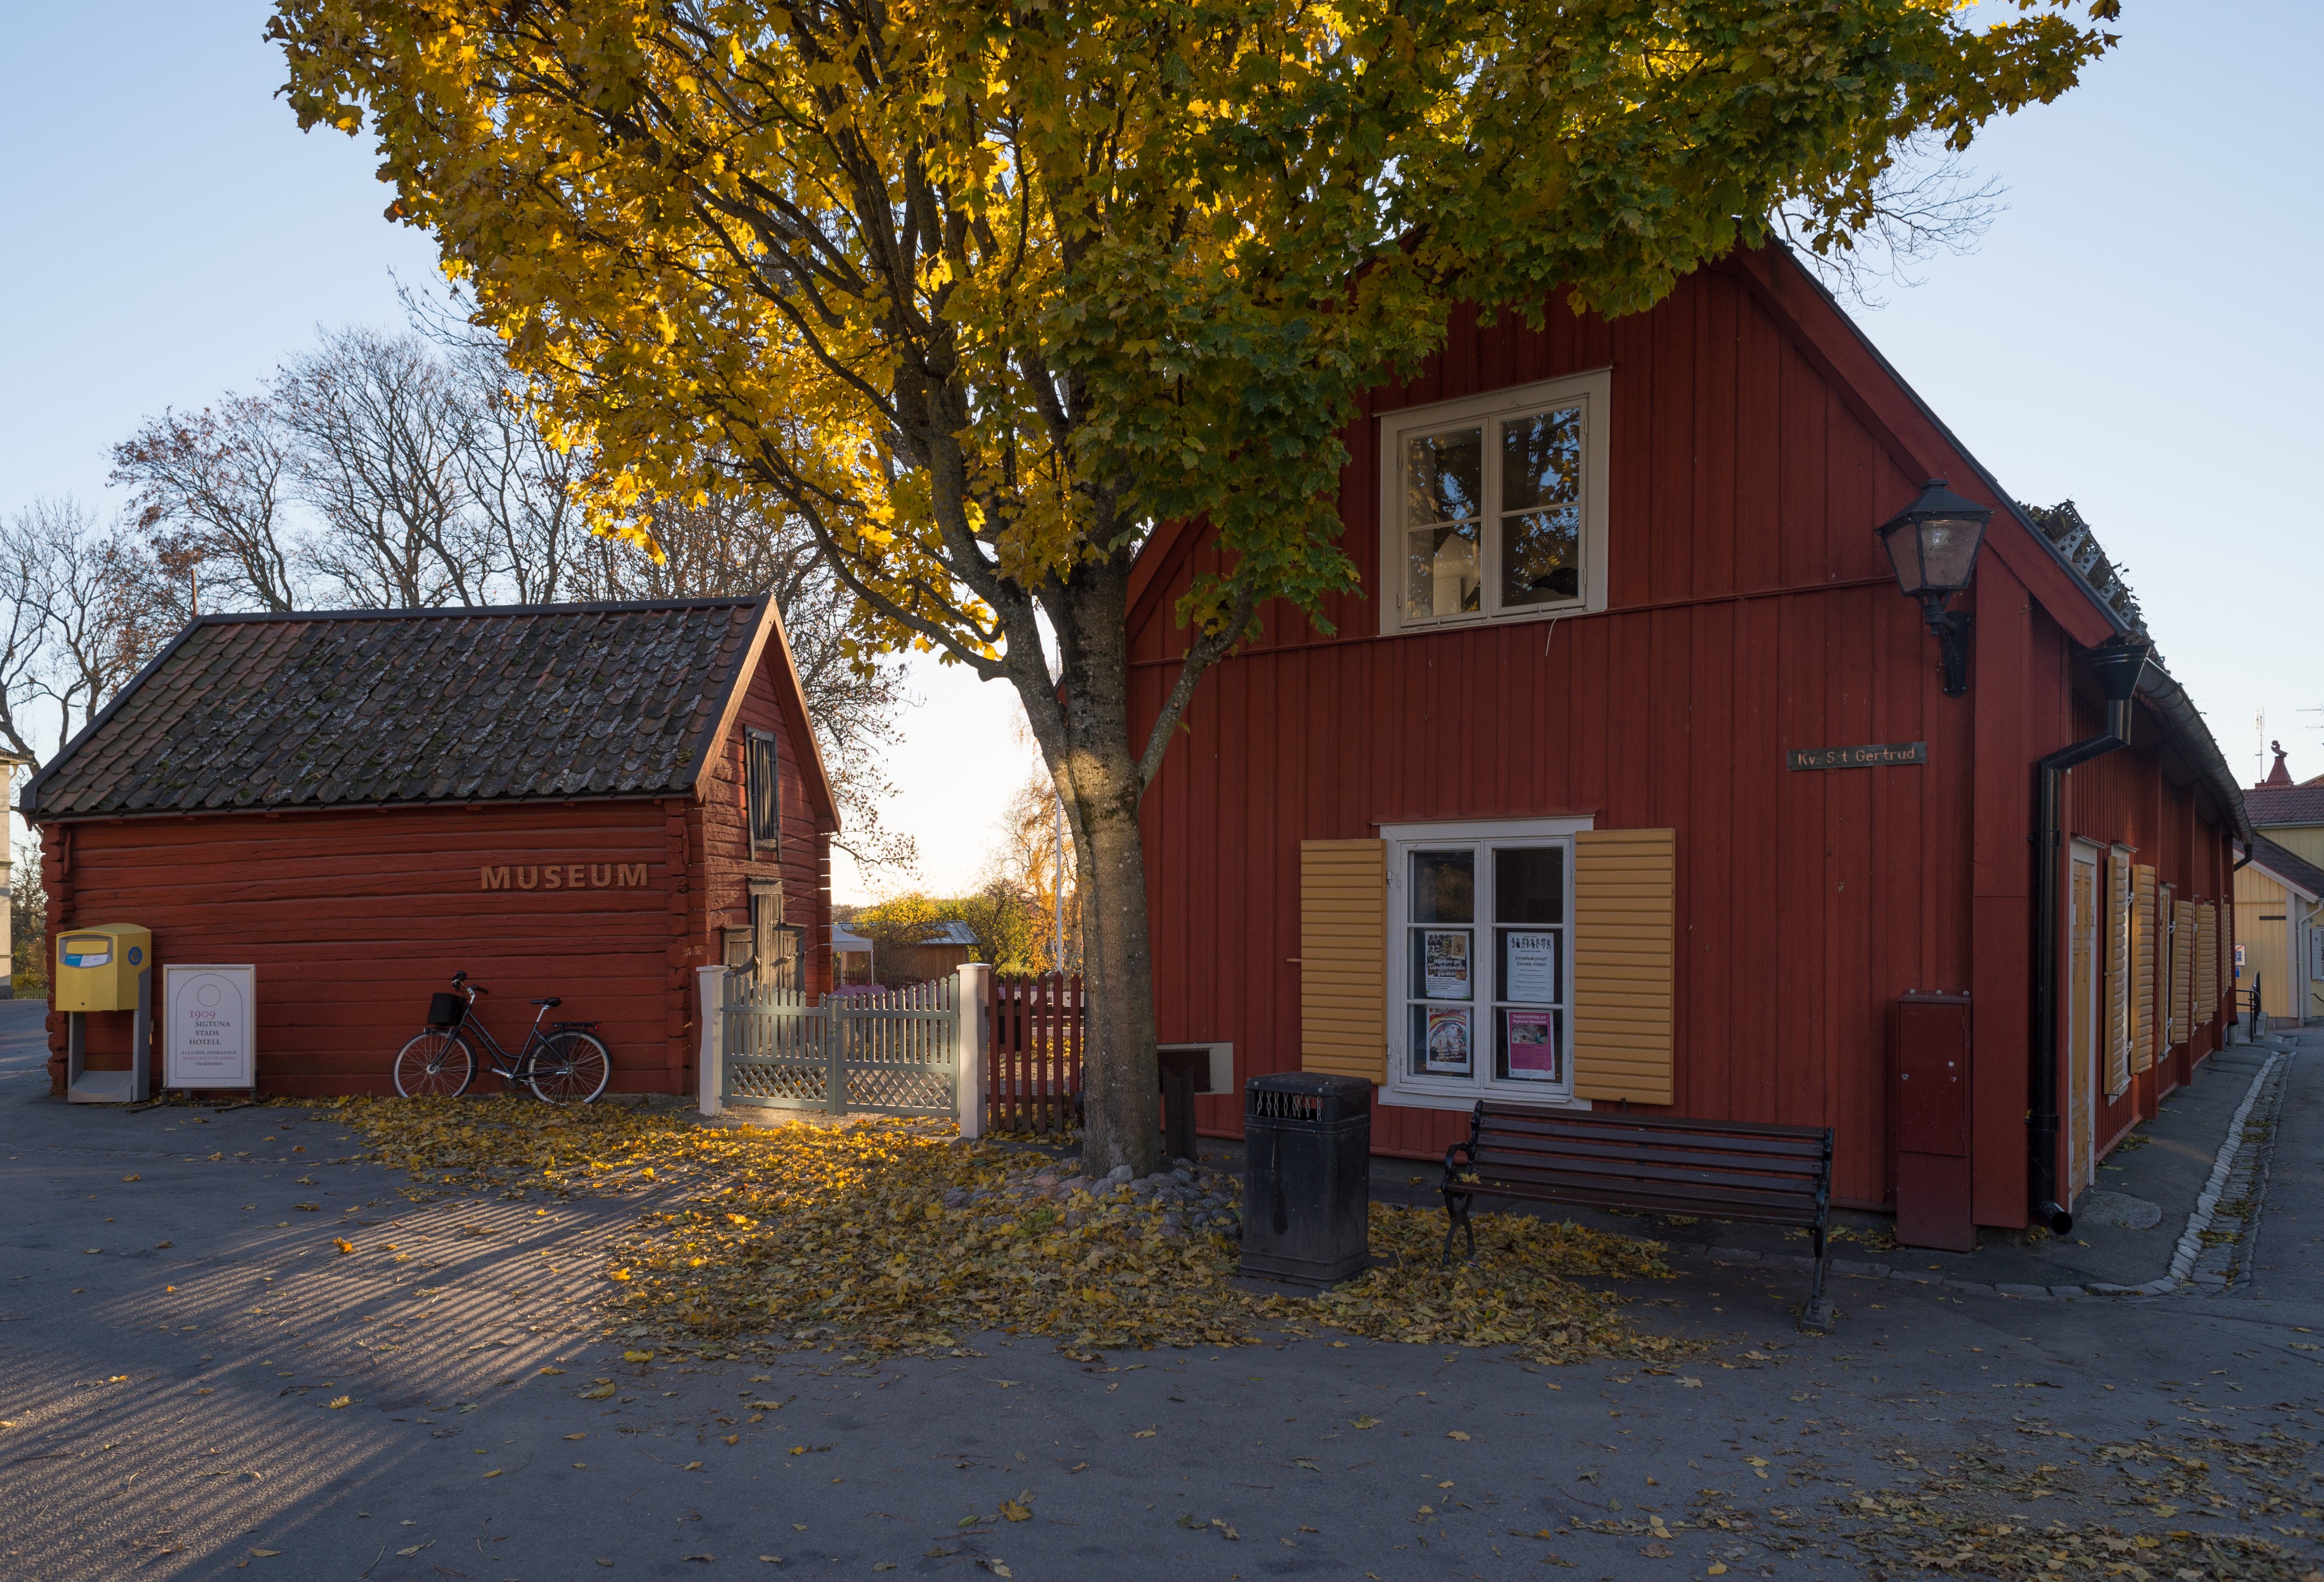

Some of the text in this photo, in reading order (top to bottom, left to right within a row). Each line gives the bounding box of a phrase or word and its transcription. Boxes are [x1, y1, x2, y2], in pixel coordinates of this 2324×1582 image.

[1798, 753, 1820, 766] Kv.
[1855, 747, 1916, 763] Gertrud
[481, 864, 647, 889] MUSEUM
[190, 1010, 216, 1021] 1909
